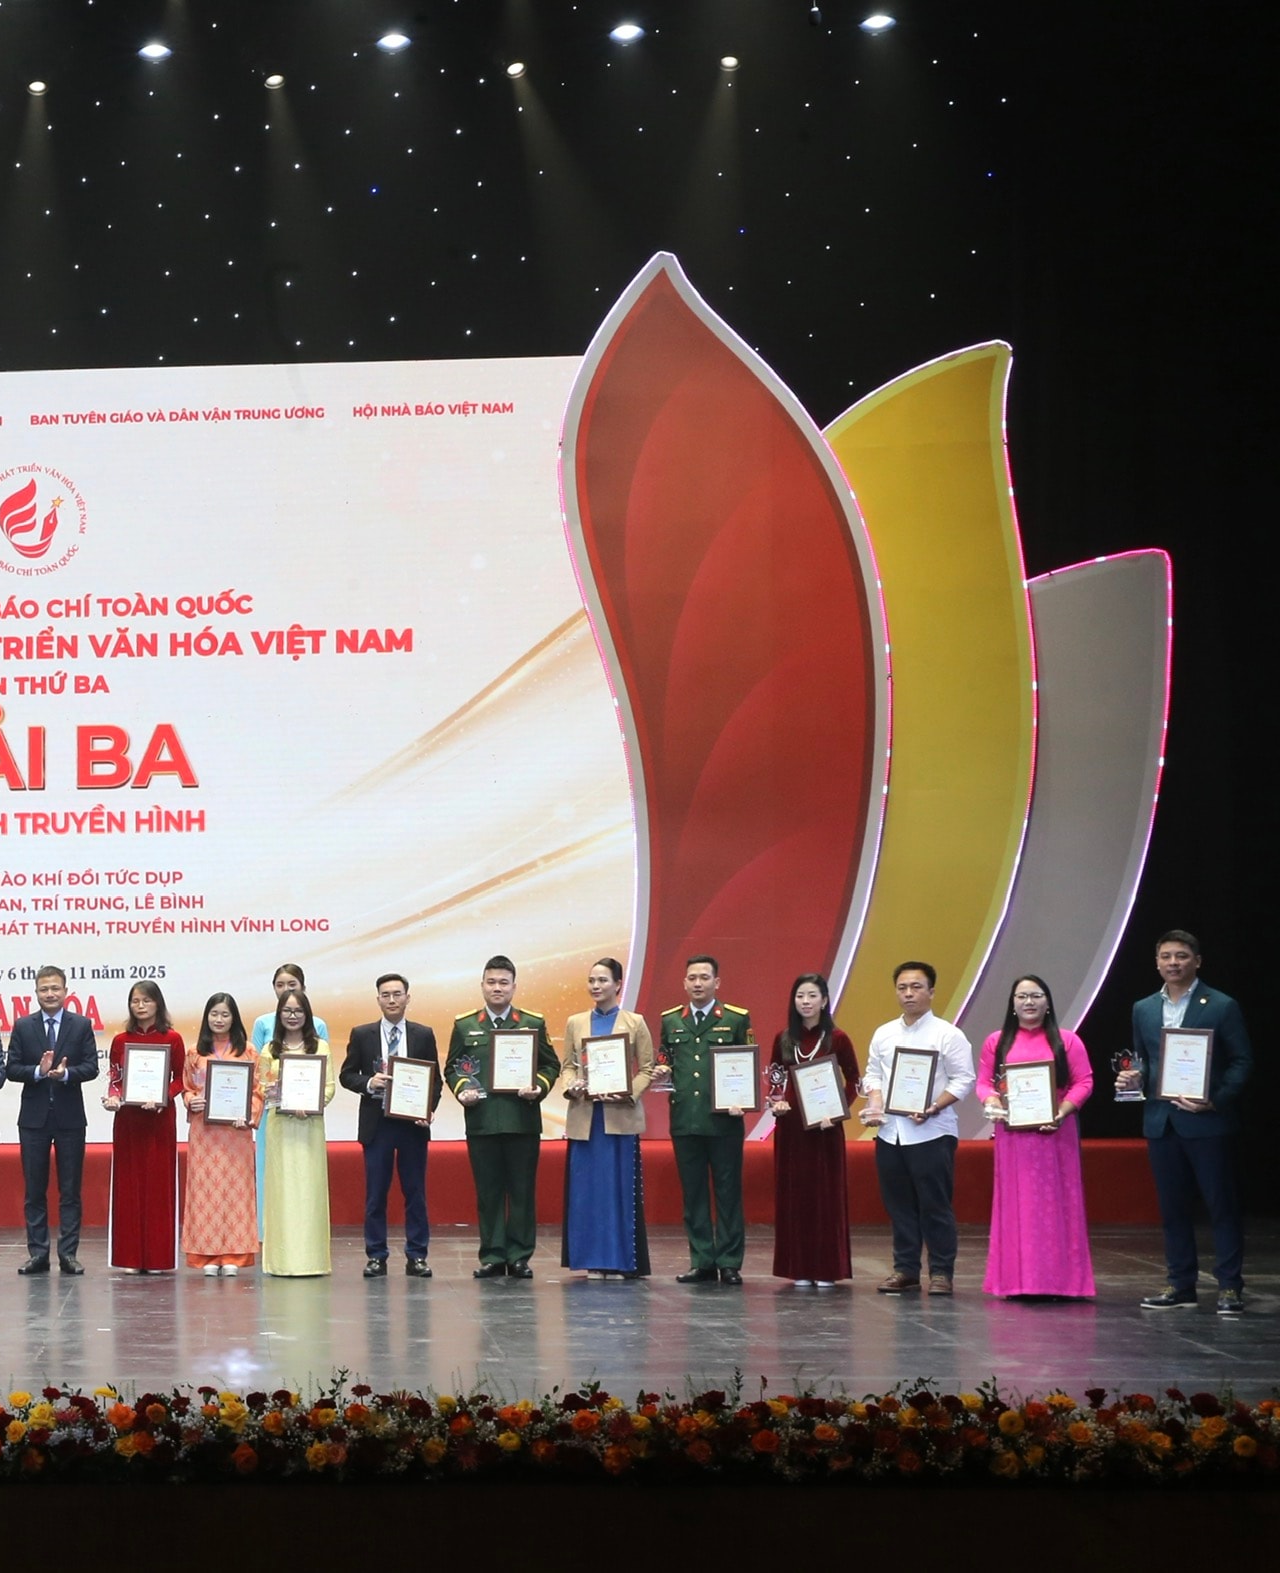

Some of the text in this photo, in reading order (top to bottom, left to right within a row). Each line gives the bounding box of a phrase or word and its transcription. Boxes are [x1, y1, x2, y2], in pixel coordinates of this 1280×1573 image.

[29, 405, 325, 426] BAN TUYÊN GIÁO VÀ DÂN VẬN TRUNG ƯƠNG
[352, 400, 514, 420] HỘI NHÀ BÁO VIỆT NAM
[45, 592, 93, 619] CHÍ
[95, 591, 169, 618] TOÀN
[175, 588, 254, 620] QUỐC
[87, 626, 159, 659] VĂN
[169, 625, 244, 657] HÓA
[250, 623, 328, 662] VIỆT
[335, 627, 414, 654] NAM
[13, 670, 68, 696] THỨ
[73, 674, 111, 695] BA
[75, 723, 200, 791] BA
[13, 803, 127, 836] TRUYỀN
[134, 804, 206, 834] HÌNH
[32, 869, 63, 887] KHÍ
[66, 867, 100, 886] ĐỒI
[103, 868, 140, 886] TỨC
[145, 870, 184, 888] DỤP
[30, 893, 60, 912] TRÍ
[63, 895, 130, 913] TRUNG,
[134, 892, 156, 910] LÊ
[159, 892, 204, 911] BÌNH
[32, 921, 101, 937] THANH,
[104, 916, 176, 935] TRUYỀN
[180, 916, 226, 934] HÌNH
[229, 916, 275, 933] VĨNH
[280, 918, 330, 933] LONG
[7, 967, 16, 980] 6
[70, 967, 86, 979] 11
[91, 965, 126, 979] năm
[129, 965, 166, 979] 2025
